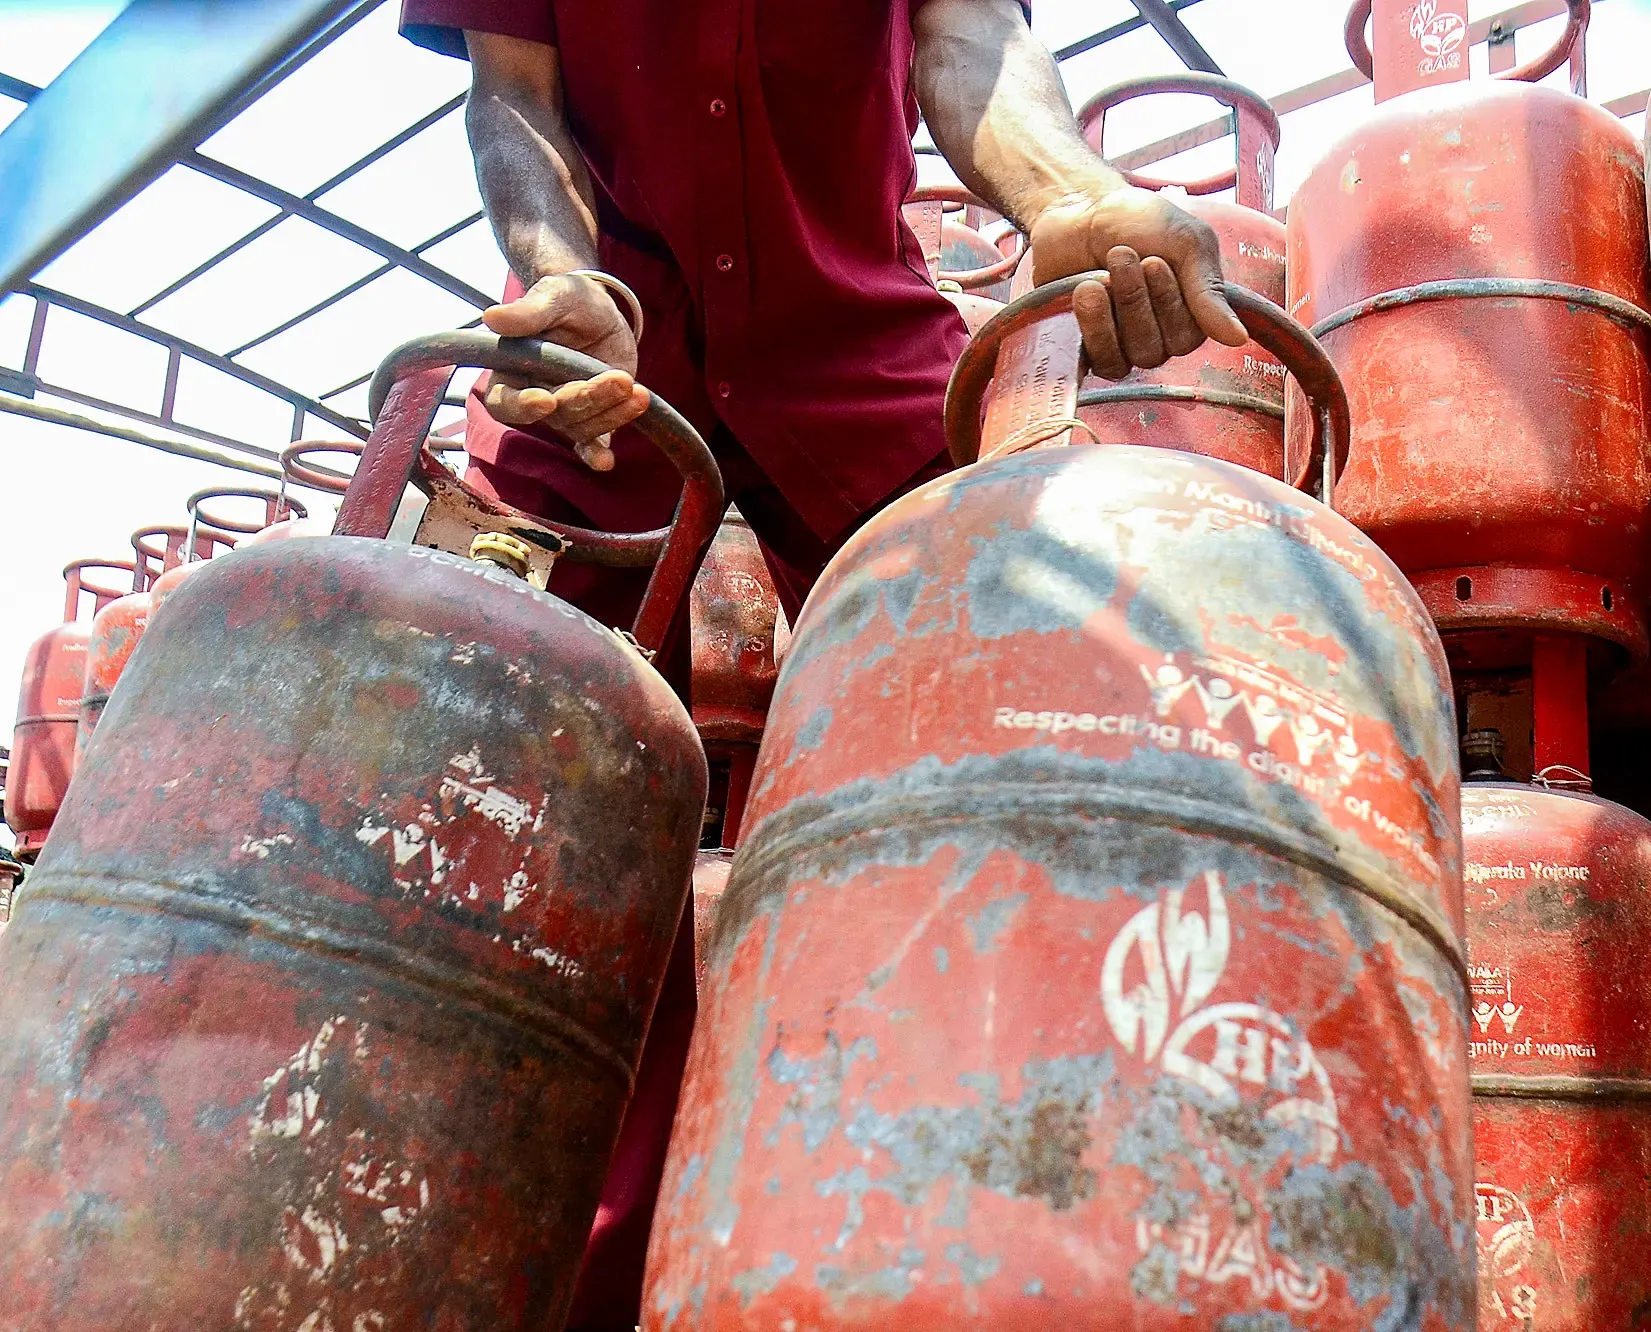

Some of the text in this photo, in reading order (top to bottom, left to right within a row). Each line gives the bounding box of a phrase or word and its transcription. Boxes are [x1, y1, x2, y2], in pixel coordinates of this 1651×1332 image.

[1432, 17, 1458, 35] HP
[1418, 52, 1461, 74] GAS
[994, 706, 1182, 749] Respecting
[1190, 727, 1242, 760] the
[1344, 796, 1371, 822] of
[1514, 1036, 1532, 1056] of
[1536, 1042, 1597, 1058] women
